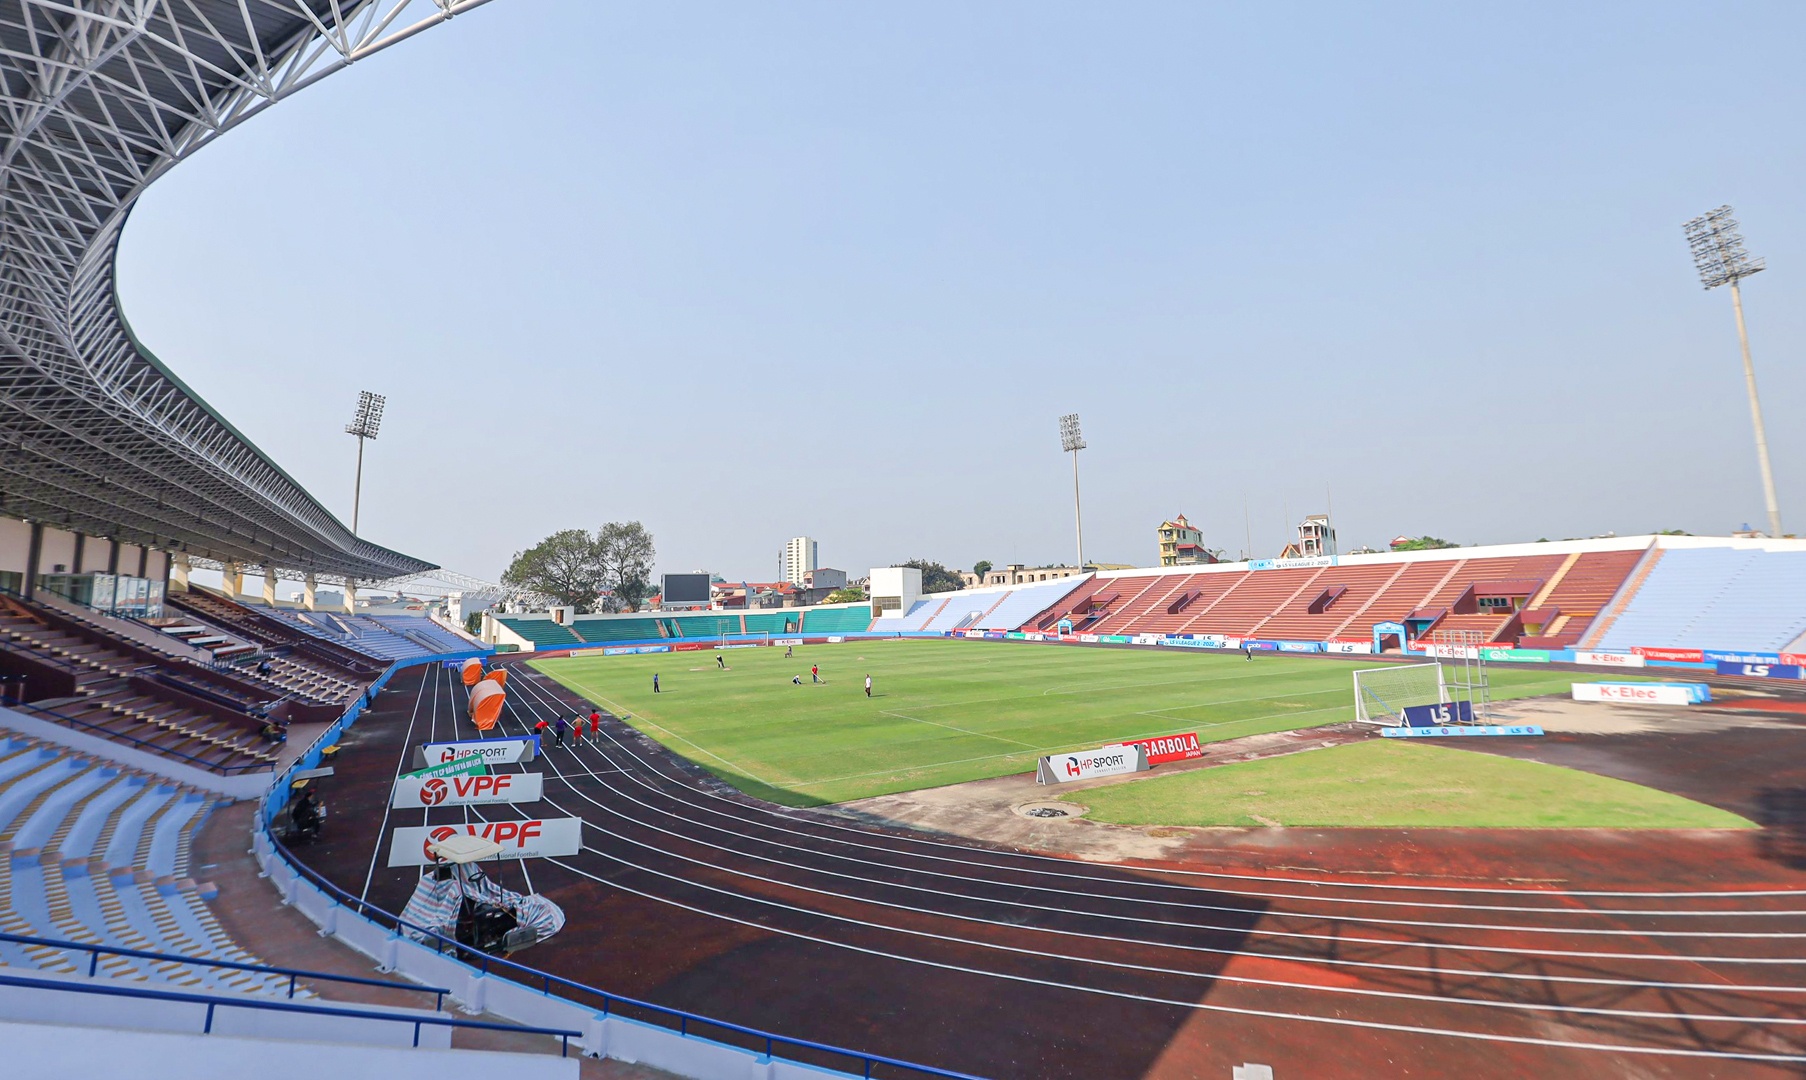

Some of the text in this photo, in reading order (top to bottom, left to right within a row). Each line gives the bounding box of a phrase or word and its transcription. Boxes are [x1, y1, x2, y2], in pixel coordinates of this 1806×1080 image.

[1591, 654, 1626, 662] K-Elec
[1742, 665, 1769, 677] LS
[1599, 686, 1657, 699] K-Elec
[1430, 707, 1451, 724] LS
[1185, 750, 1201, 758] JAPAN
[453, 775, 511, 797] VPF
[466, 820, 542, 848] VPF
[517, 850, 539, 858] Football
